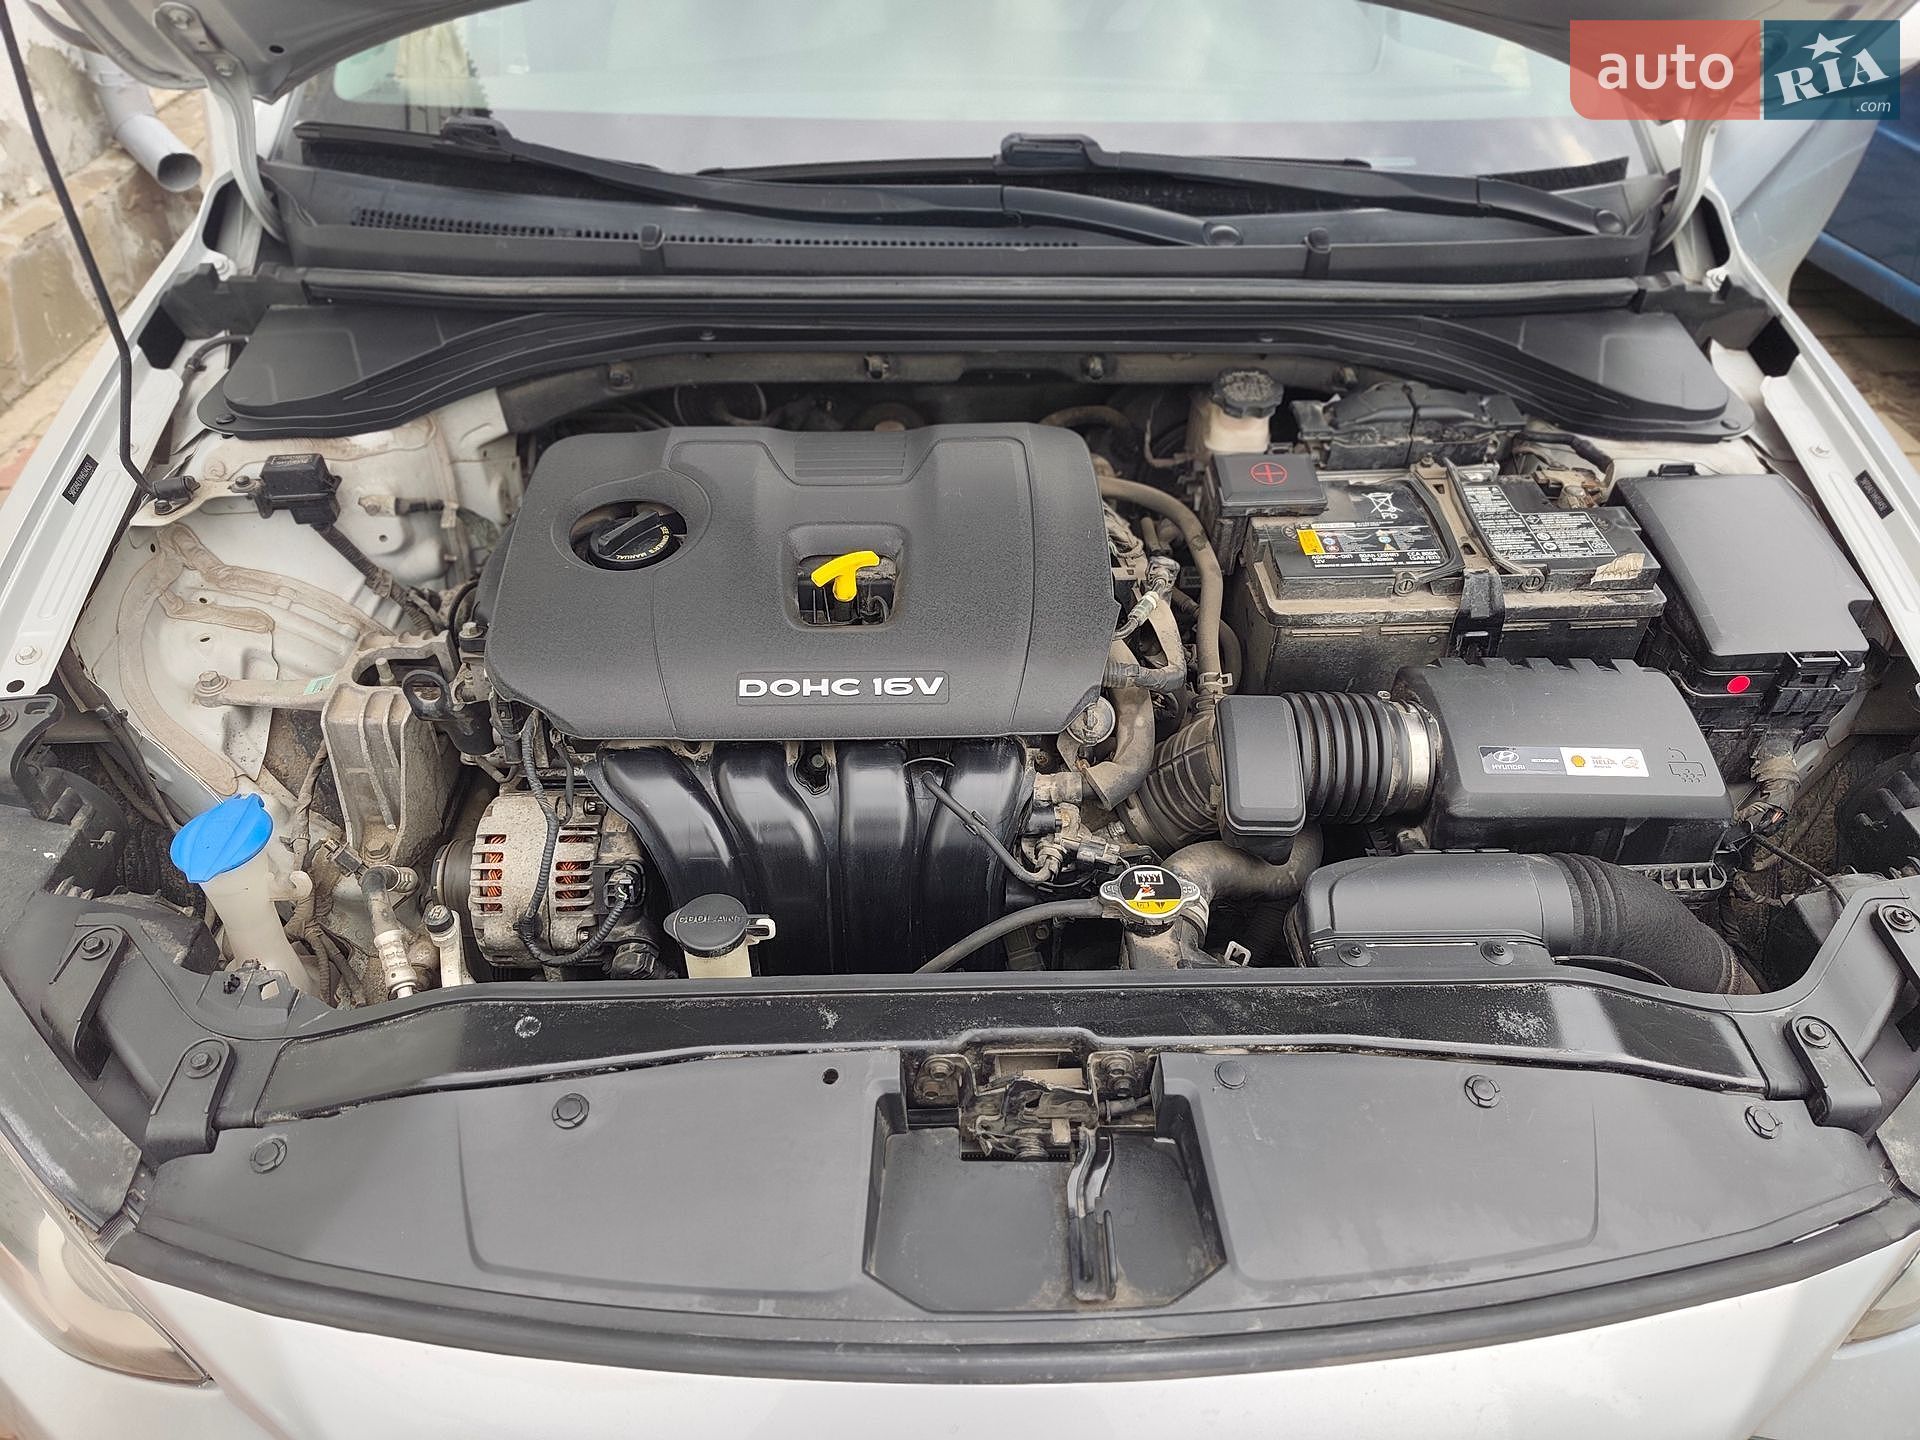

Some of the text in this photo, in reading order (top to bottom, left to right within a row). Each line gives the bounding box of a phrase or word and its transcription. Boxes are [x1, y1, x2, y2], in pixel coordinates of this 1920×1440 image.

[616, 552, 647, 560] MANUAL
[738, 677, 945, 697] DOHC 16V
